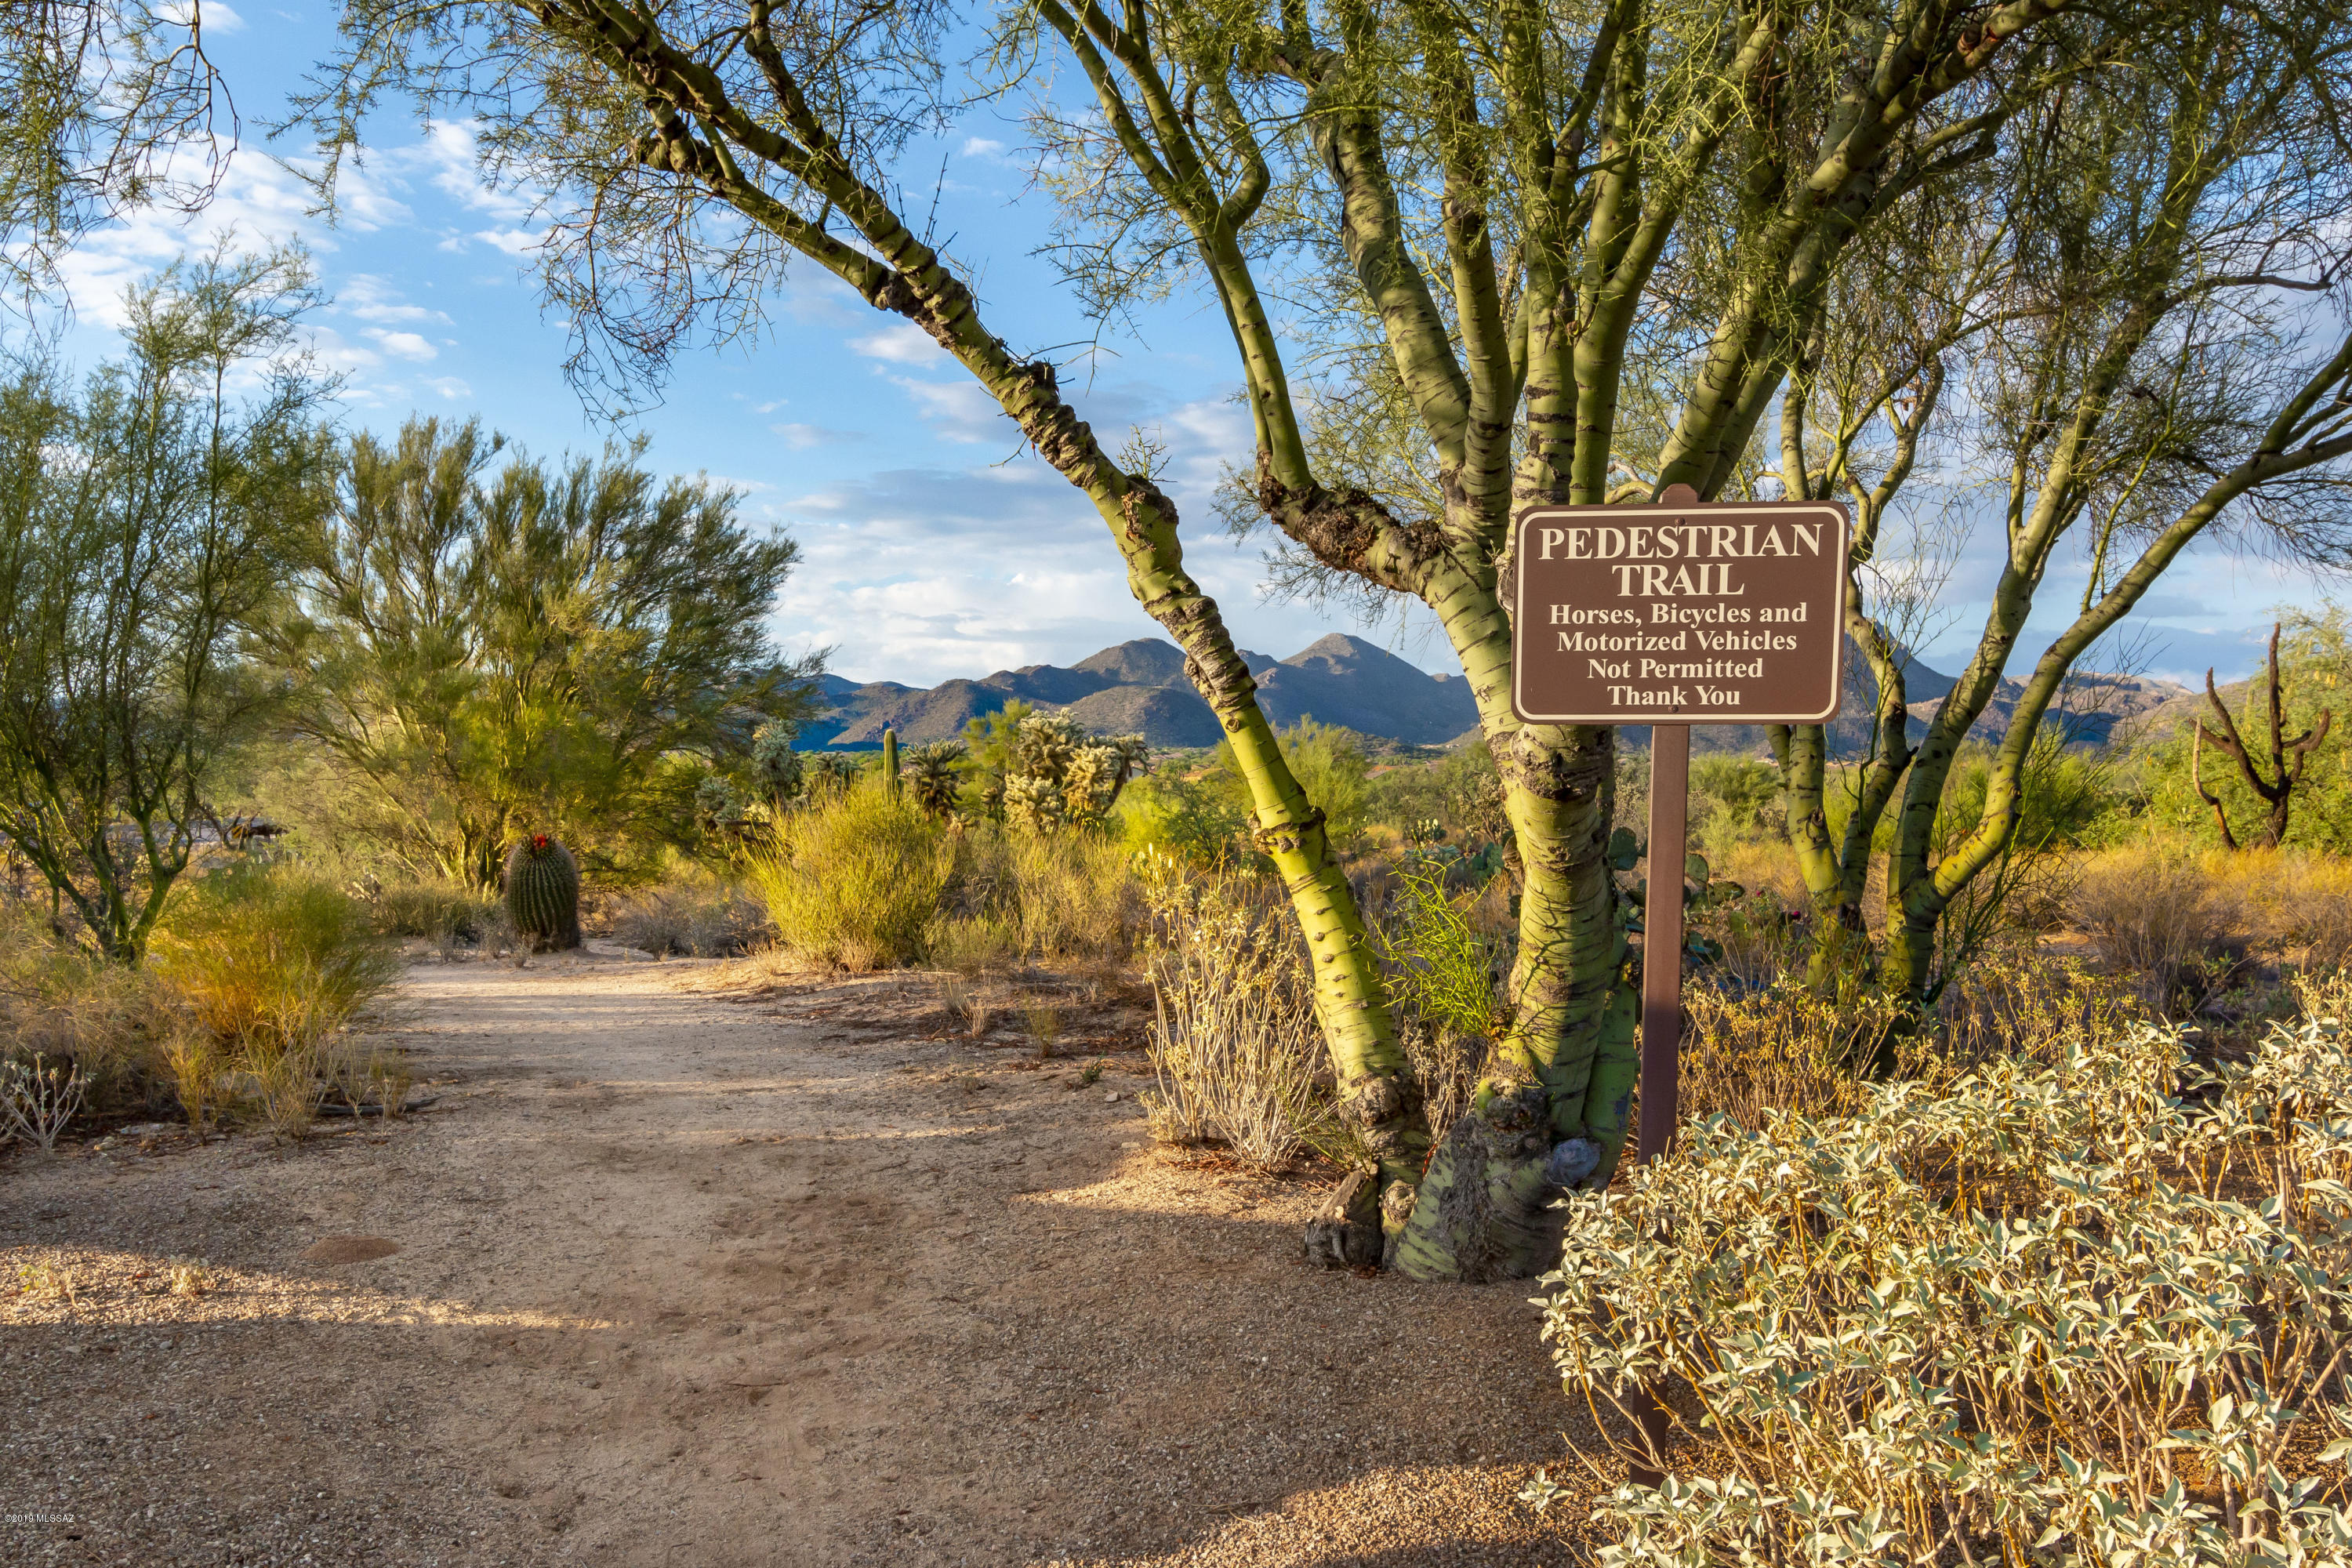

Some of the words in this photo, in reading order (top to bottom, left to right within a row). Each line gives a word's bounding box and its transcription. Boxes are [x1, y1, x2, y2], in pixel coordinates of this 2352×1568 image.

[1538, 524, 1824, 559] PEDESTRIAN
[1612, 564, 1744, 596] TRAIL
[1550, 604, 1641, 627] Horses,
[1650, 603, 1750, 628] Bicycles
[1760, 602, 1806, 622] and
[1557, 631, 1686, 651] Motorized
[1695, 630, 1796, 650] Vehicles
[1588, 659, 1631, 678] Not
[1639, 658, 1762, 677] Permitted
[1607, 686, 1687, 705] Thank
[1695, 686, 1740, 705] You
